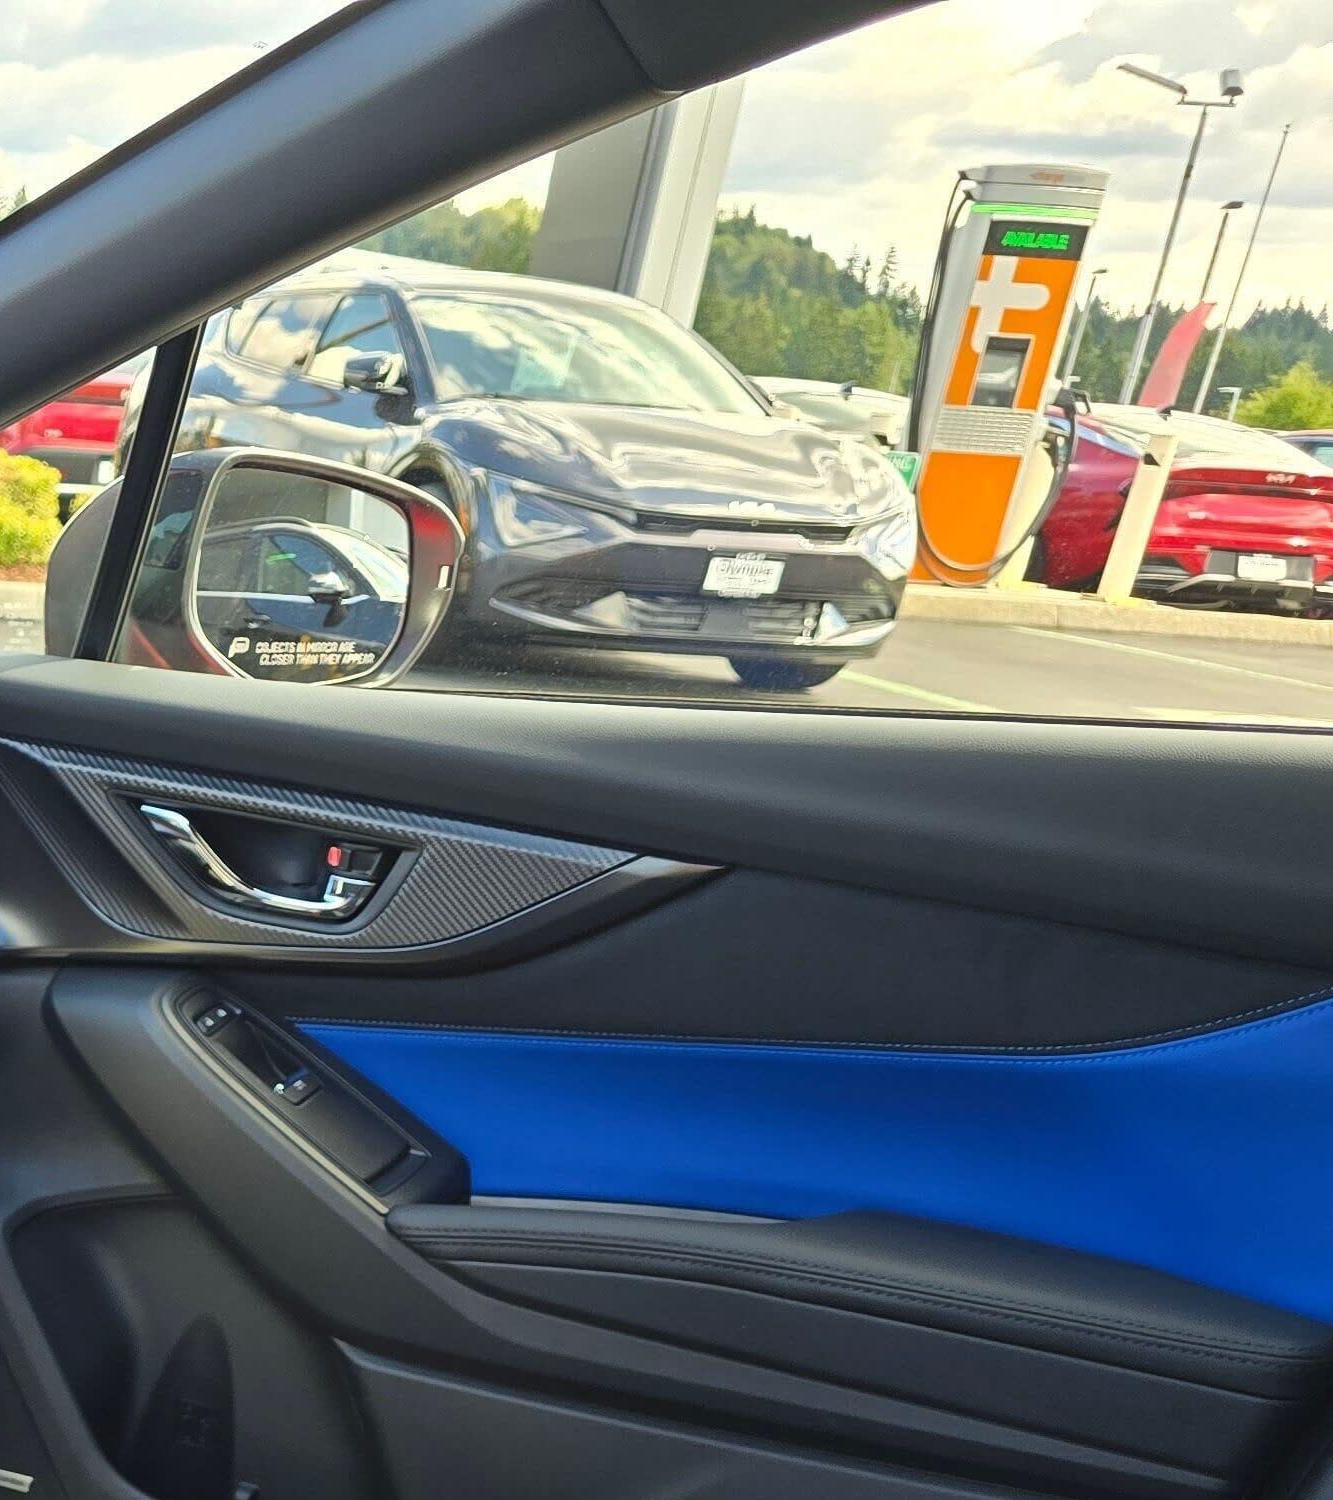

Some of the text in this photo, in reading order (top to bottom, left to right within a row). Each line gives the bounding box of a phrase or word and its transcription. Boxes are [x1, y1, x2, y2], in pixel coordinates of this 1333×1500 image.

[255, 641, 296, 653] OBJECTS
[307, 642, 337, 653] MIRROR
[338, 641, 357, 653] ARE
[260, 653, 376, 666] CLOSER THAN THEY APPEAR
